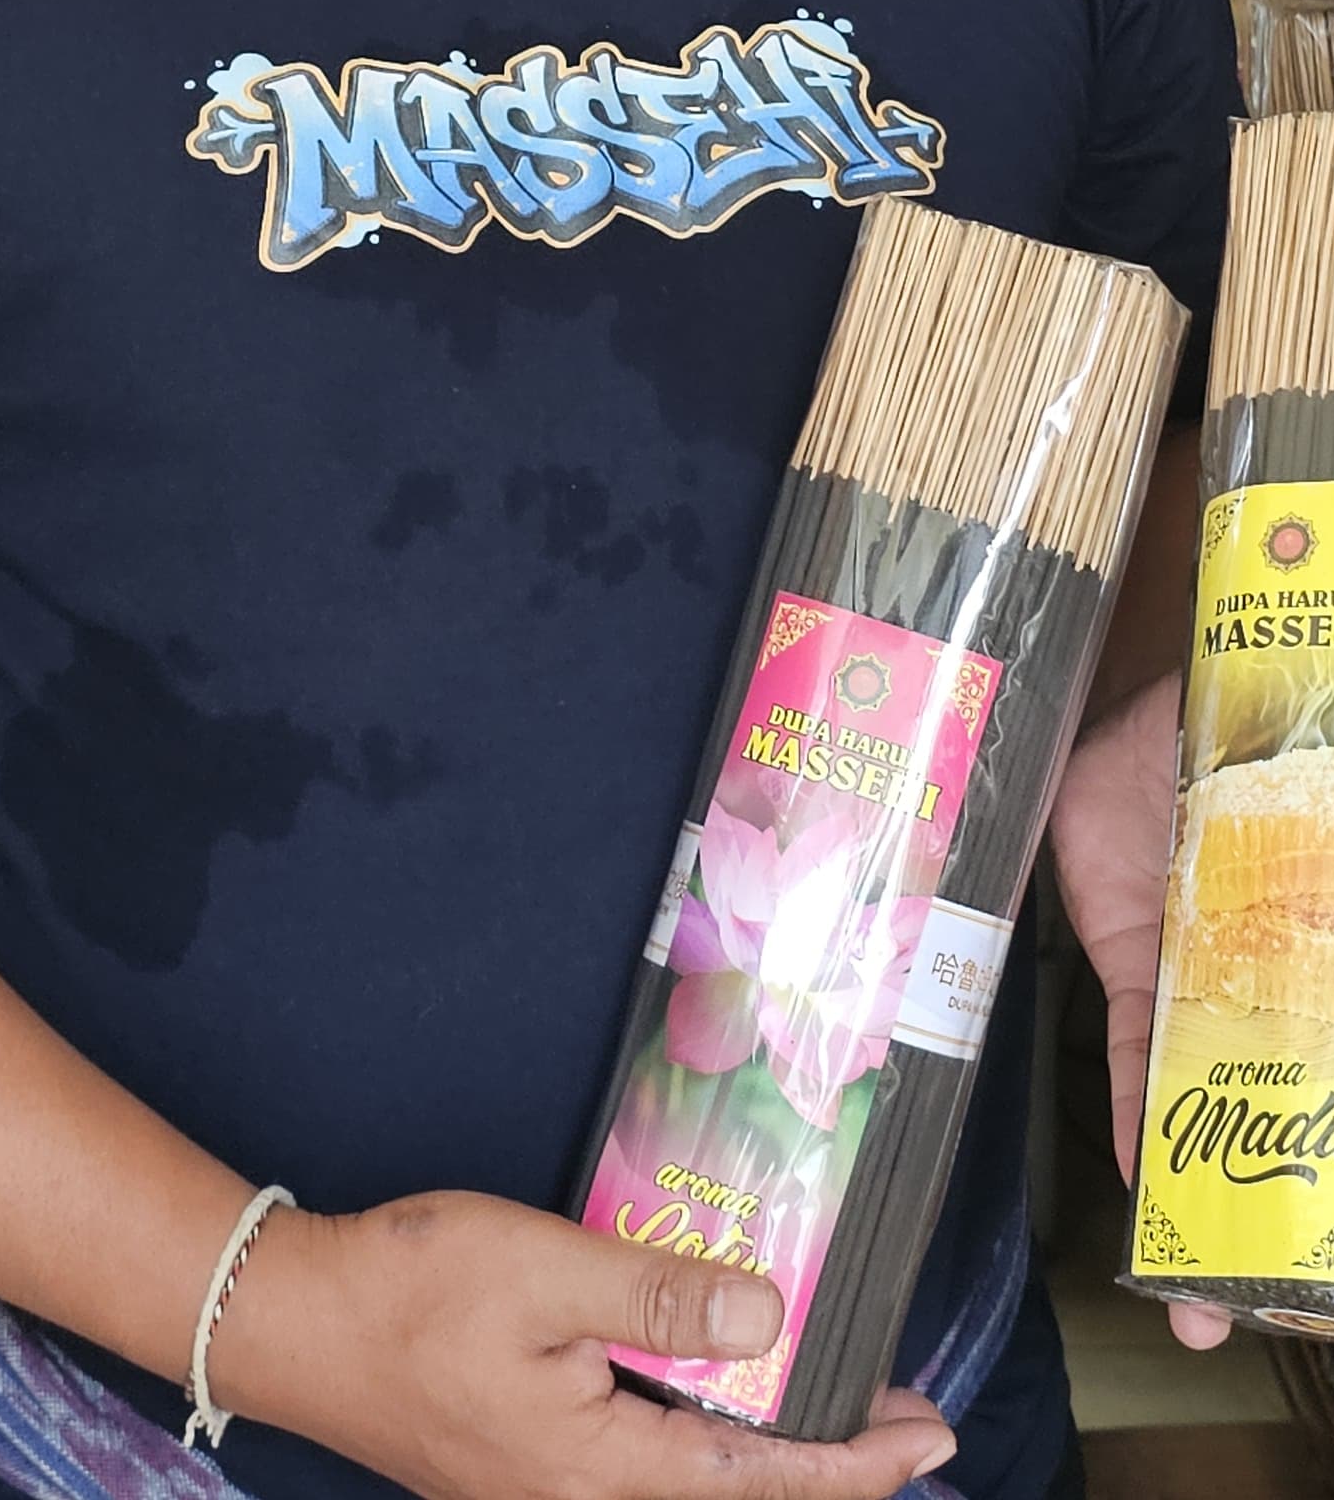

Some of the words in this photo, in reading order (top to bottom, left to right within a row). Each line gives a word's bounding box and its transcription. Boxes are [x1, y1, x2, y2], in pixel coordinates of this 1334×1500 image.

[257, 25, 937, 272] MASSEHI
[1215, 592, 1269, 618] DUPA
[768, 704, 831, 742] DUPA
[836, 724, 917, 772] HARU
[1207, 1059, 1308, 1089] aroma
[653, 1160, 762, 1221] aroma
[614, 1200, 774, 1278] Lot
